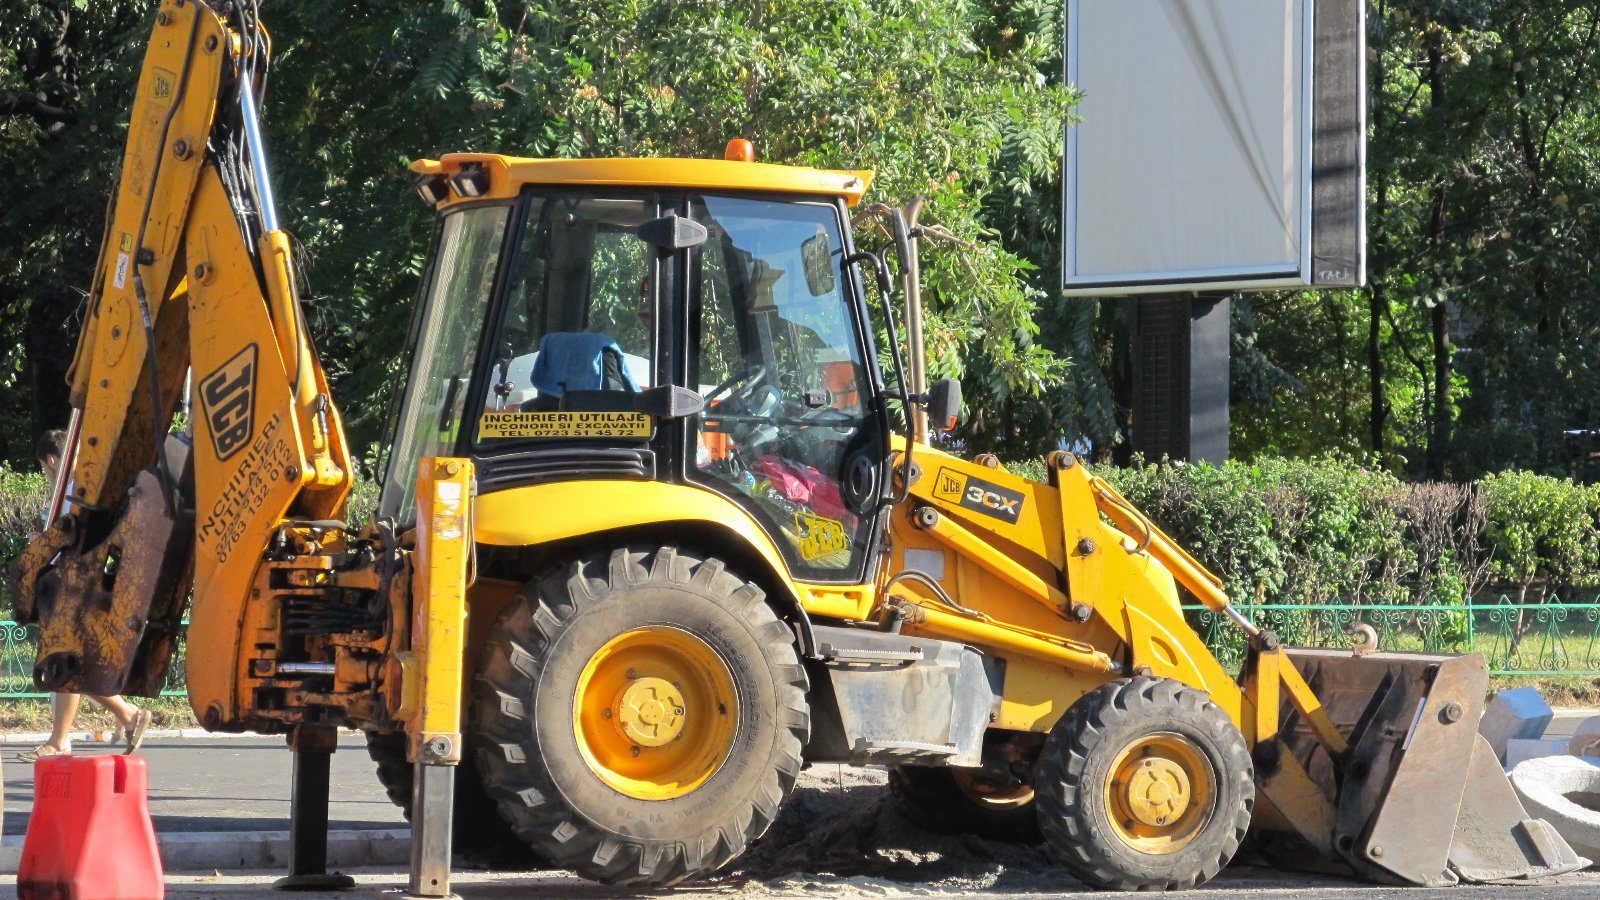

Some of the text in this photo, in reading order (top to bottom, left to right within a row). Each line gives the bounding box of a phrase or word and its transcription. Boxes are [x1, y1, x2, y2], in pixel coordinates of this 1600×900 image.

[154, 75, 170, 97] JCB
[205, 362, 252, 454] JCB
[484, 413, 646, 423] INCHIRIERI UTILAJE
[263, 438, 287, 473] 572
[198, 412, 280, 543] INCHIRIERI
[213, 438, 276, 537] UTILAJE
[942, 476, 961, 493] JCB
[219, 520, 248, 564] 0763
[247, 484, 270, 516] 132
[270, 447, 293, 482] 012
[966, 485, 1019, 516] 3CX
[801, 517, 844, 556] JCB
